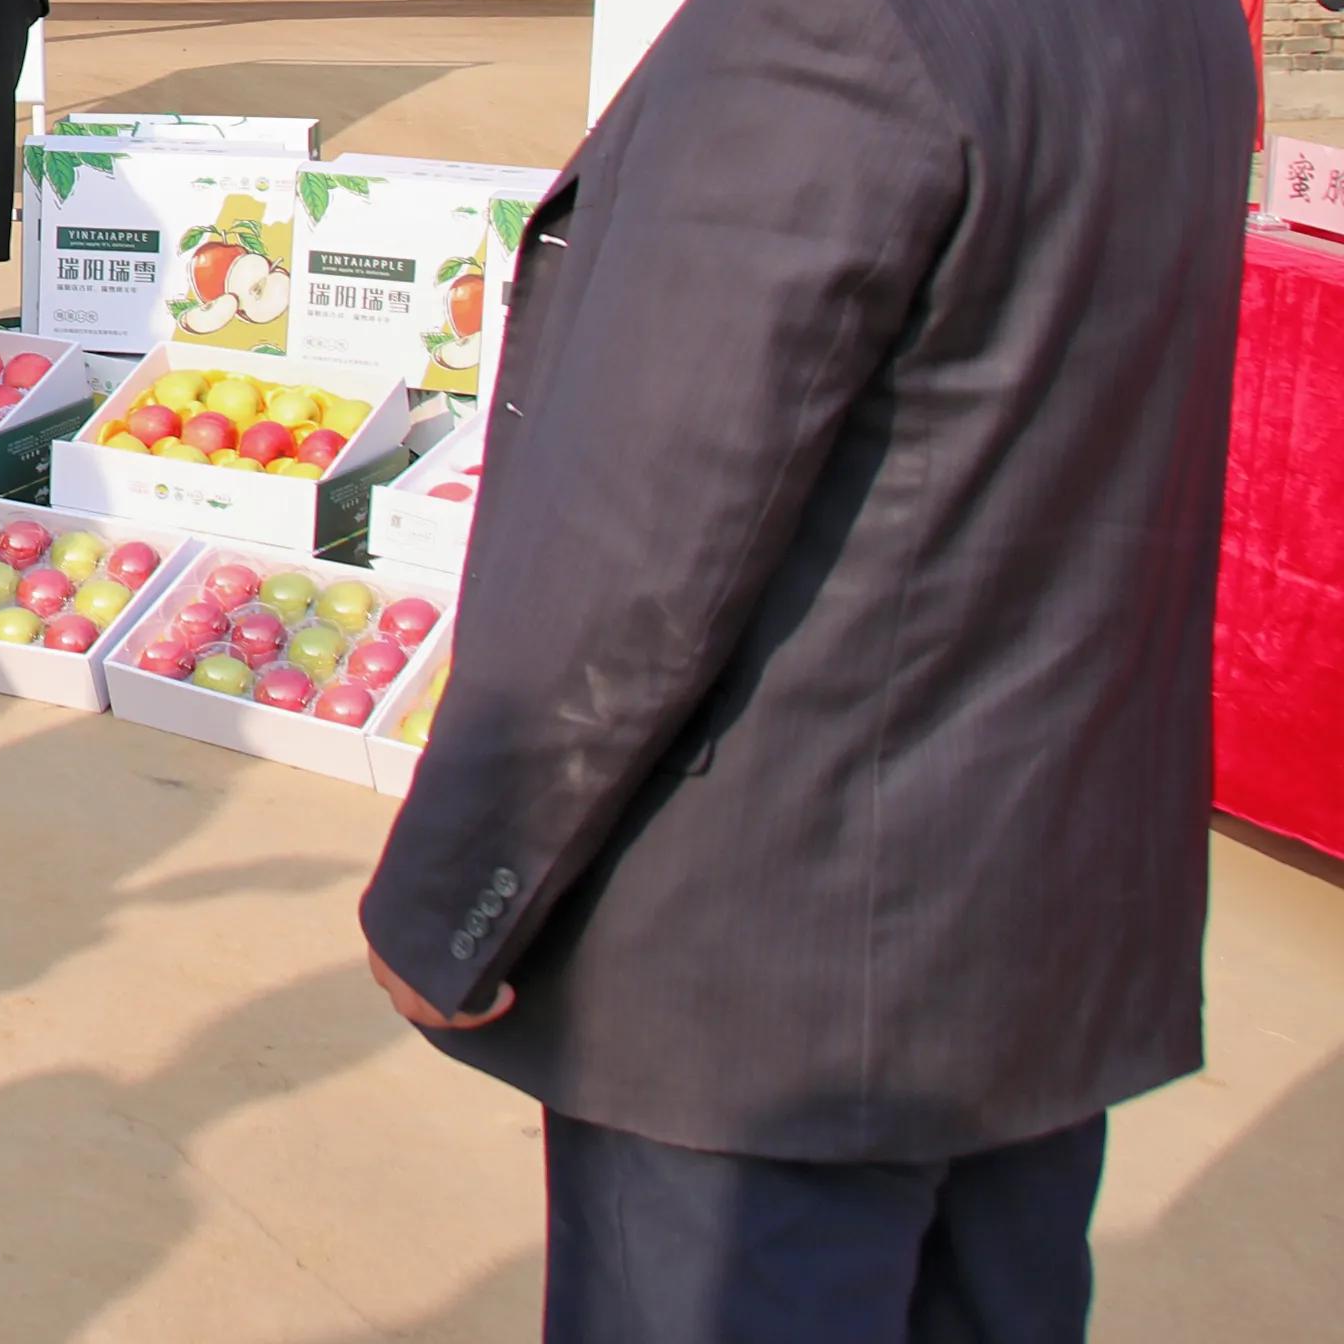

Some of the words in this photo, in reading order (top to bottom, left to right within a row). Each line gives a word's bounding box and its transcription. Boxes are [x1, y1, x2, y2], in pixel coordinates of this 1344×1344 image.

[68, 230, 149, 243] YINTAIAPPLE
[56, 257, 156, 284] 瑞阳瑞雪
[320, 254, 405, 272] YINTAIAPPLE
[308, 282, 411, 314] 瑞阳瑞雪
